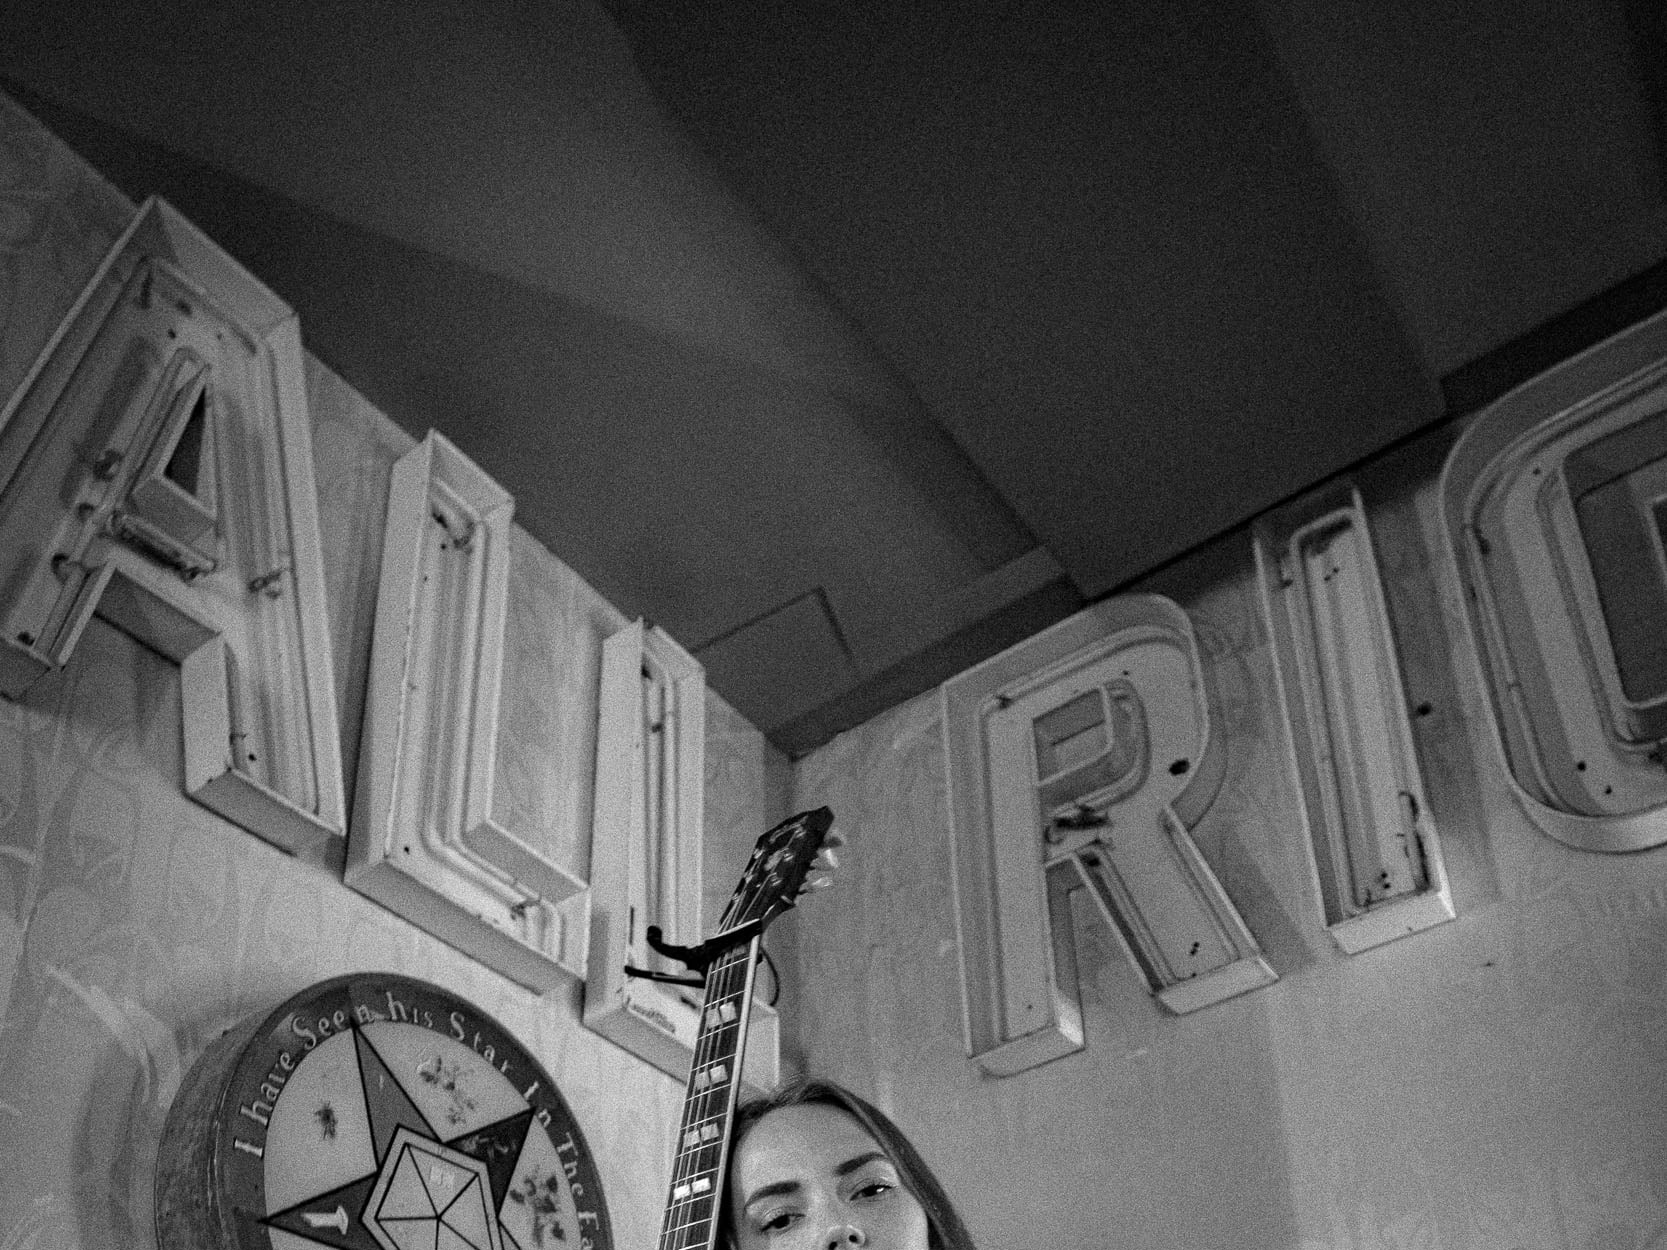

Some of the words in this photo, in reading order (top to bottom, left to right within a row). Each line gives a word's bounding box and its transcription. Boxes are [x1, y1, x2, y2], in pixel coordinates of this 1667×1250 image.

[234, 1138, 264, 1158] I
[291, 1003, 376, 1050] Seen
[386, 991, 434, 1028] his
